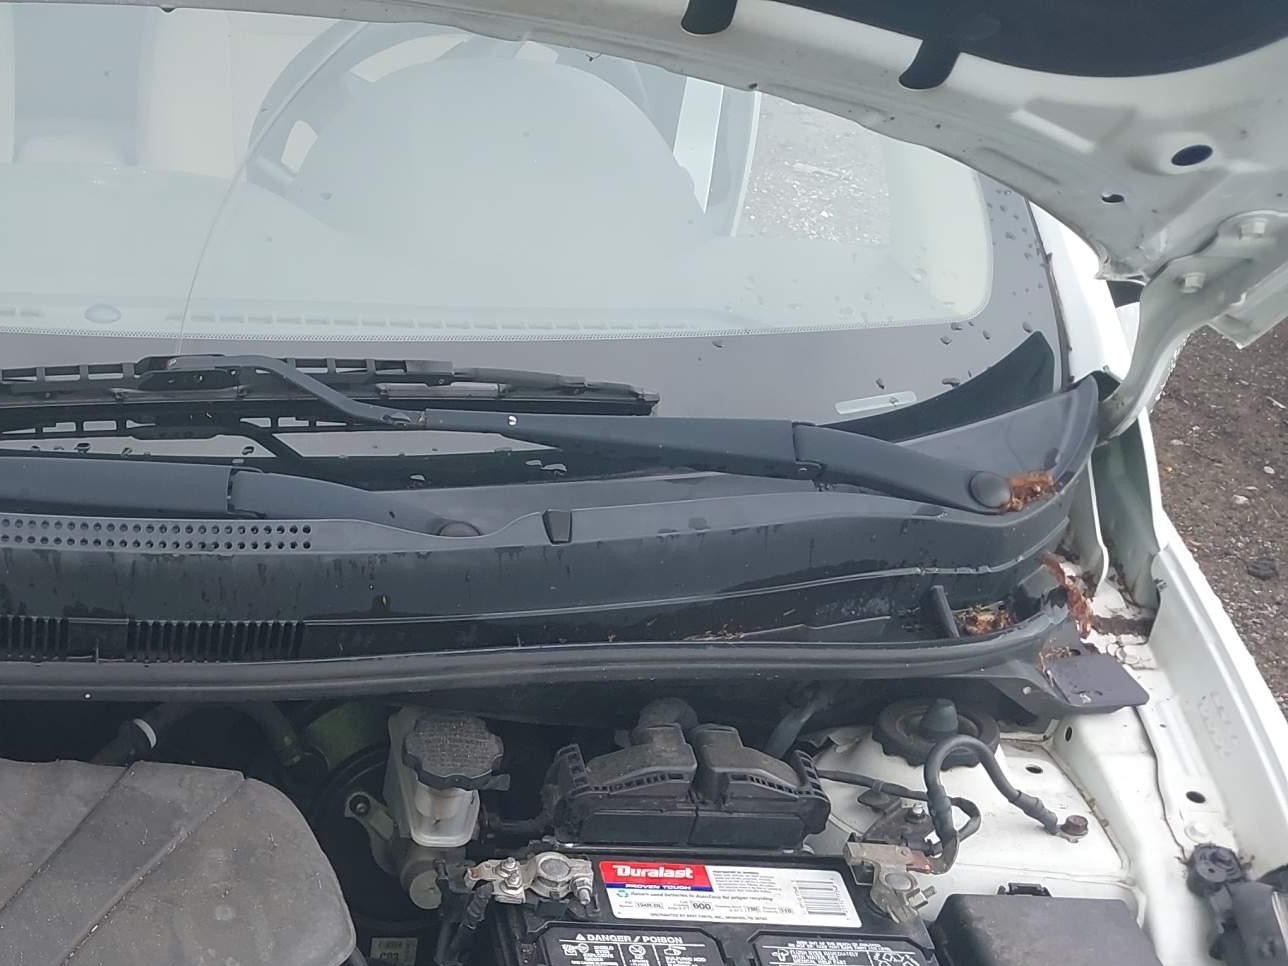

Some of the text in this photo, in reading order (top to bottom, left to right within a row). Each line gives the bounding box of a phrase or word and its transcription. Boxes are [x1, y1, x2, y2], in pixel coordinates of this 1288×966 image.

[613, 865, 693, 878] Duralast
[693, 903, 712, 911] 600
[587, 934, 631, 943] DANGER
[642, 936, 683, 944] POISON
